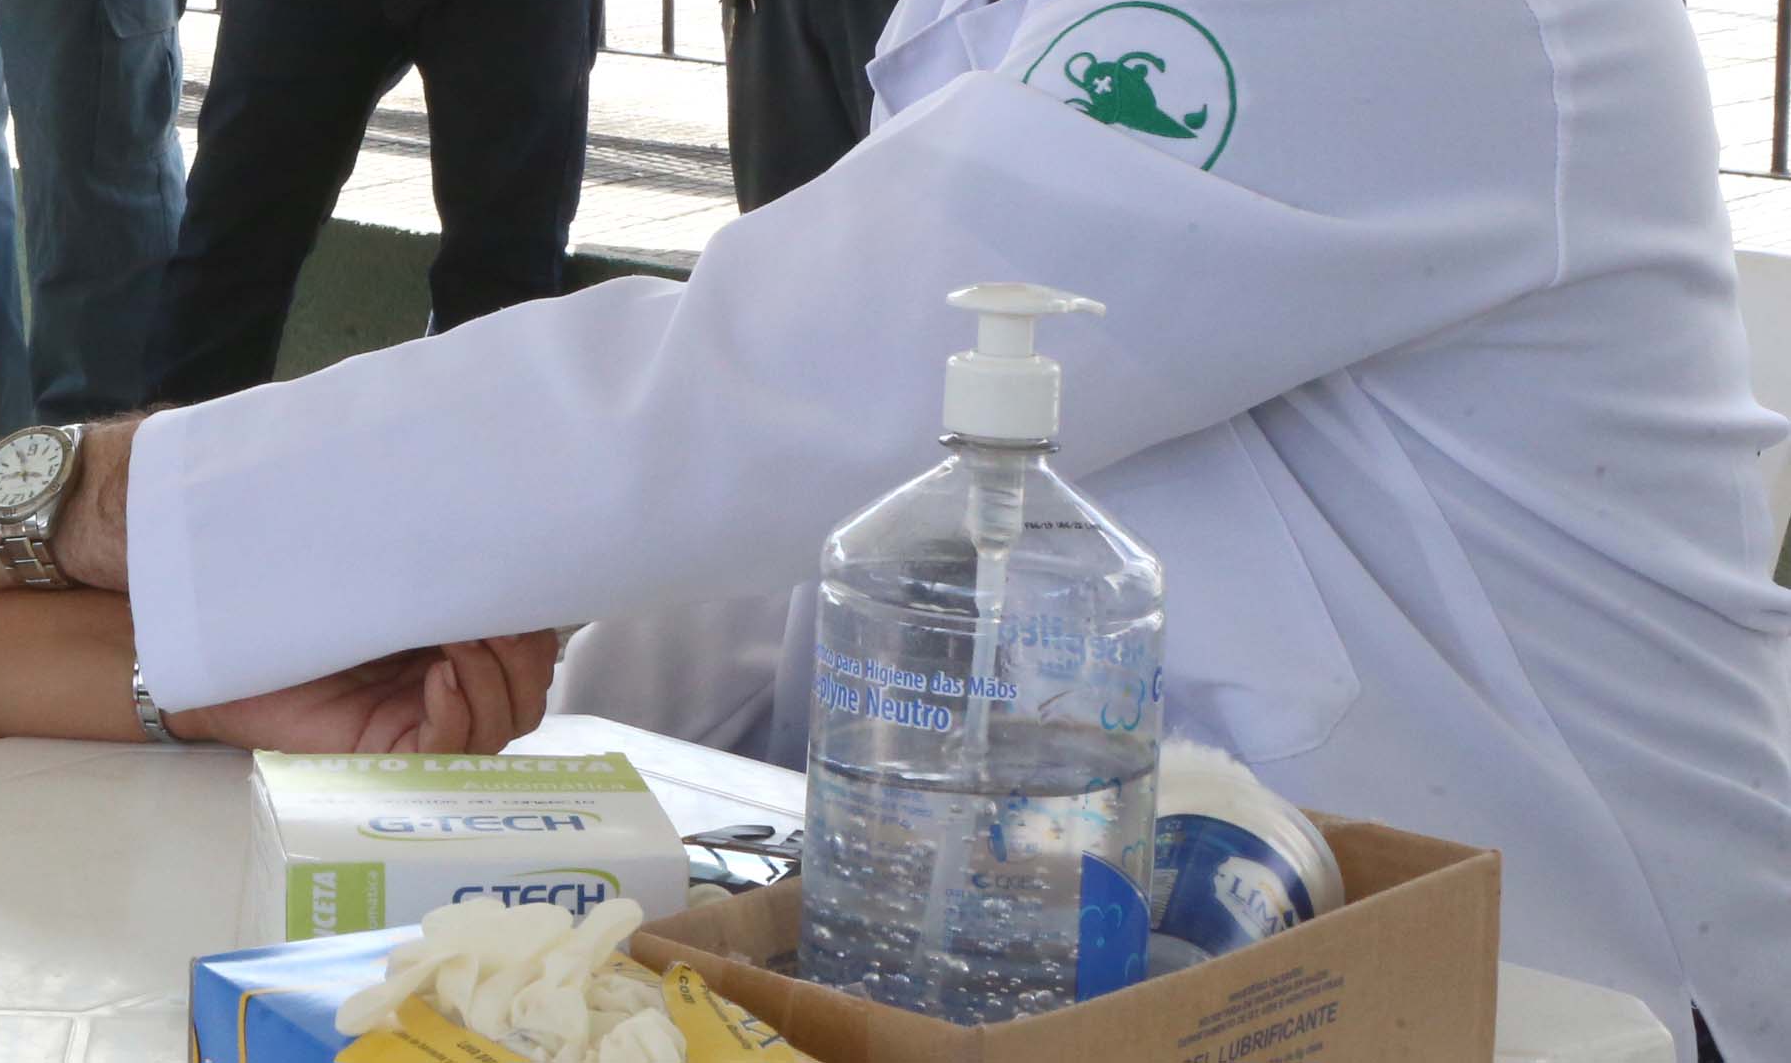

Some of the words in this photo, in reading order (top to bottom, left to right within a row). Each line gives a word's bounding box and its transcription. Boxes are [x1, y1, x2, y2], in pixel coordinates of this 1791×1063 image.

[835, 654, 860, 675] para
[866, 658, 925, 688] Higiene
[930, 671, 962, 694] das
[969, 676, 1018, 699] Mãos
[865, 687, 951, 731] Neutro
[289, 759, 407, 772] AUTO
[423, 759, 616, 773] LANCETA
[1218, 1001, 1341, 1063] LUBRIFICANTE
